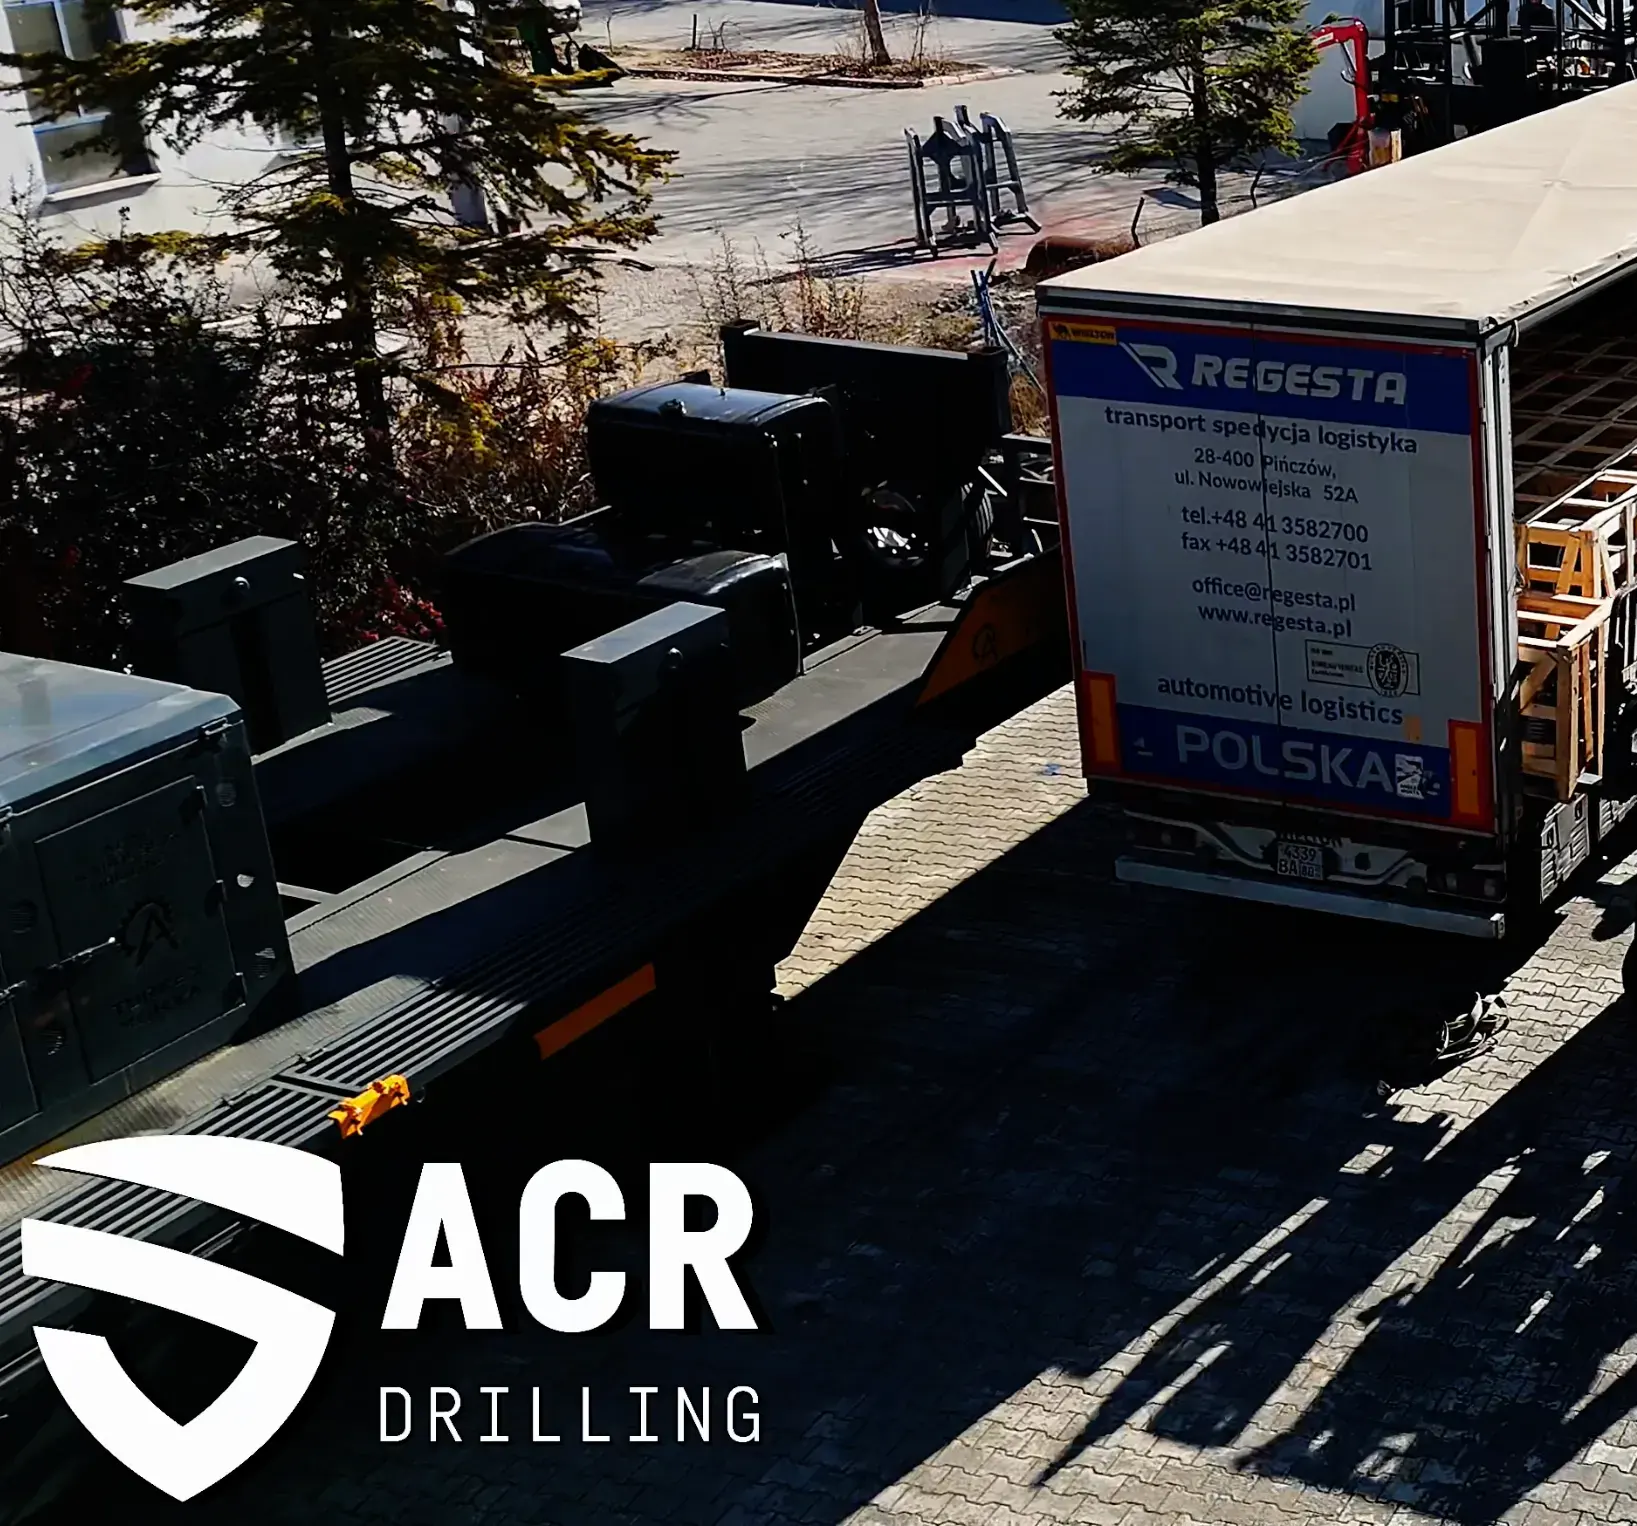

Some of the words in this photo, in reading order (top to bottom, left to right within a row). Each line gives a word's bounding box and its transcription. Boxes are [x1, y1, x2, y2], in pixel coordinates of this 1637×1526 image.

[1191, 353, 1408, 405] REGESTA
[1105, 406, 1206, 432] transport
[1213, 414, 1311, 445] spedycja
[1318, 424, 1418, 454] logistyka
[1194, 447, 1254, 467] 28-400
[1263, 455, 1336, 479] Pińczów,
[1175, 470, 1194, 486] ul.
[1199, 471, 1311, 499] Nowowiejska
[1323, 485, 1359, 503] 52A
[1182, 506, 1247, 529] tel.+48
[1253, 513, 1278, 533] 41
[1282, 517, 1369, 543] 3582700
[1181, 532, 1210, 551] fax
[1216, 537, 1251, 555] +48
[1255, 541, 1280, 561] 41
[1286, 544, 1372, 571] 3582701
[1192, 577, 1356, 613] office@regesta.pl
[1198, 605, 1351, 638] www.regesta.pl
[1157, 677, 1293, 710] automotive
[1301, 690, 1404, 725] logistics
[1176, 725, 1394, 793] POLSKA
